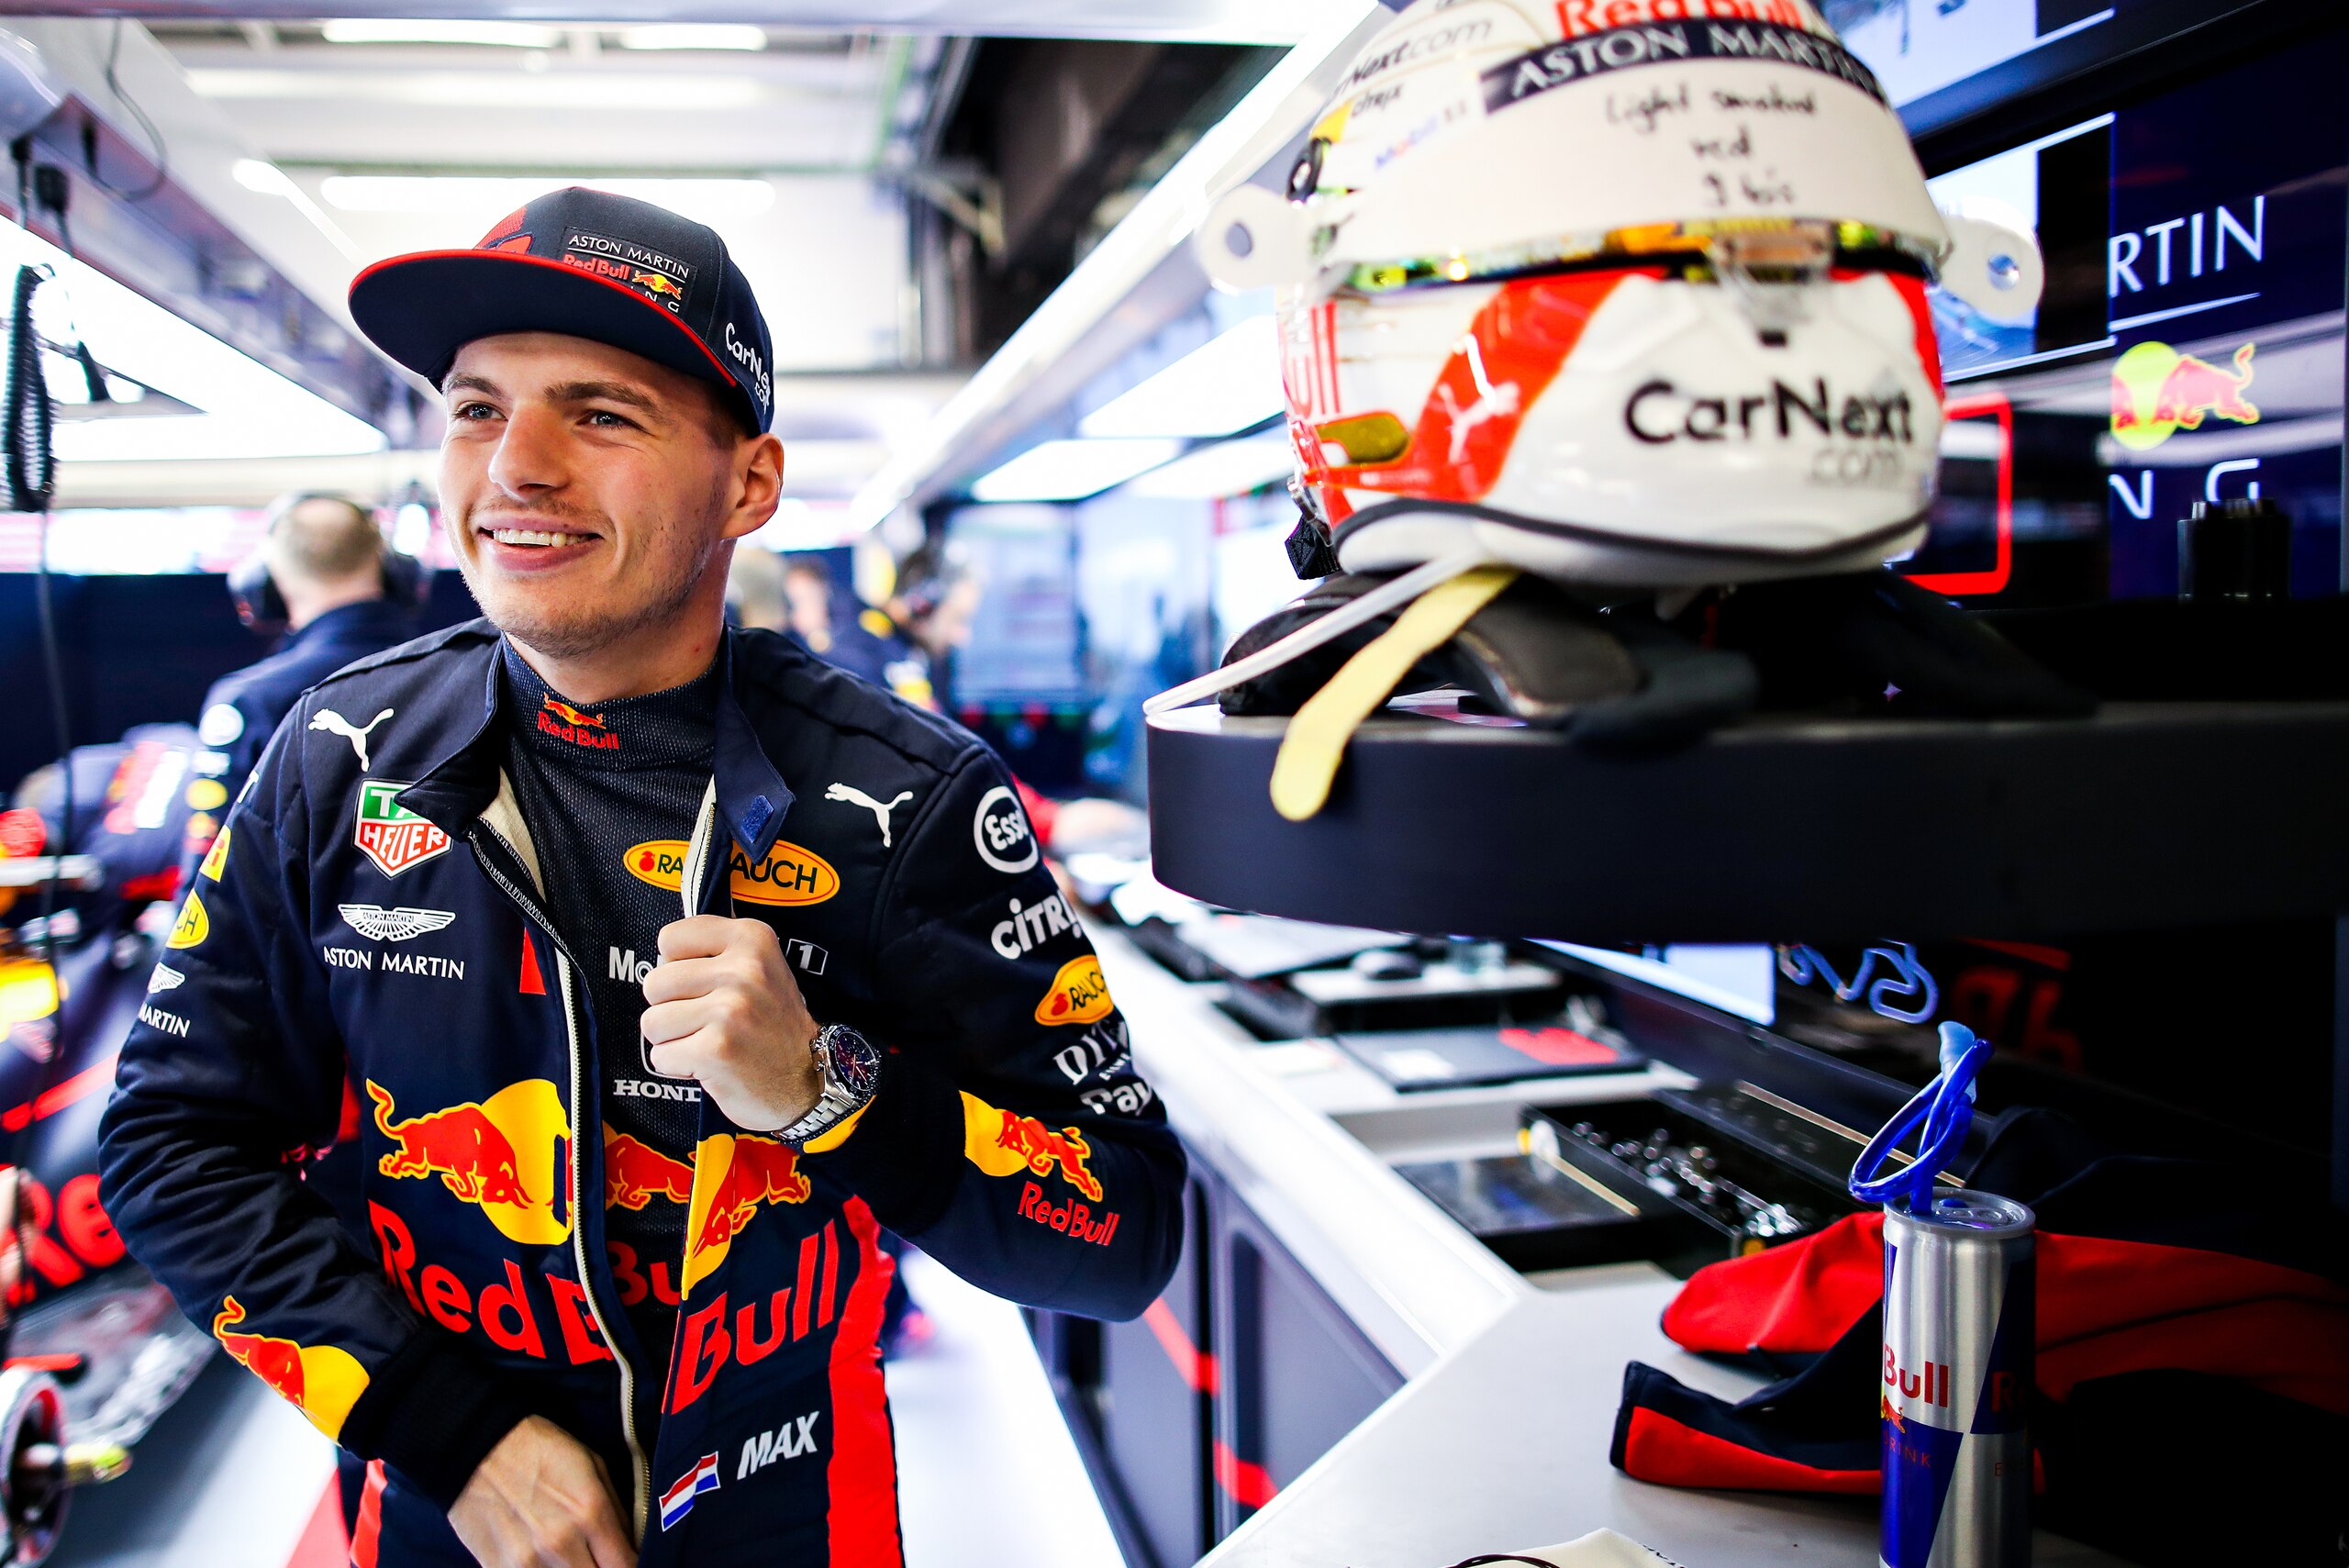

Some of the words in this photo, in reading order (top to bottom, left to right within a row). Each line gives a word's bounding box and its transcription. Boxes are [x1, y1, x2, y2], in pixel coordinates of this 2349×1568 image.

[1512, 26, 1689, 98] ASTON
[569, 235, 622, 255] ASTON
[628, 247, 689, 279] MARTIN
[1278, 301, 1341, 418] ull
[1625, 376, 1912, 444] CarNext
[363, 825, 444, 868] HEUER
[323, 946, 373, 971] ASTON
[381, 951, 465, 981] MARTIN
[368, 1199, 547, 1360] Red
[671, 1218, 840, 1415] Bull
[1884, 1342, 1949, 1407] Bull
[737, 1410, 820, 1481] MAX
